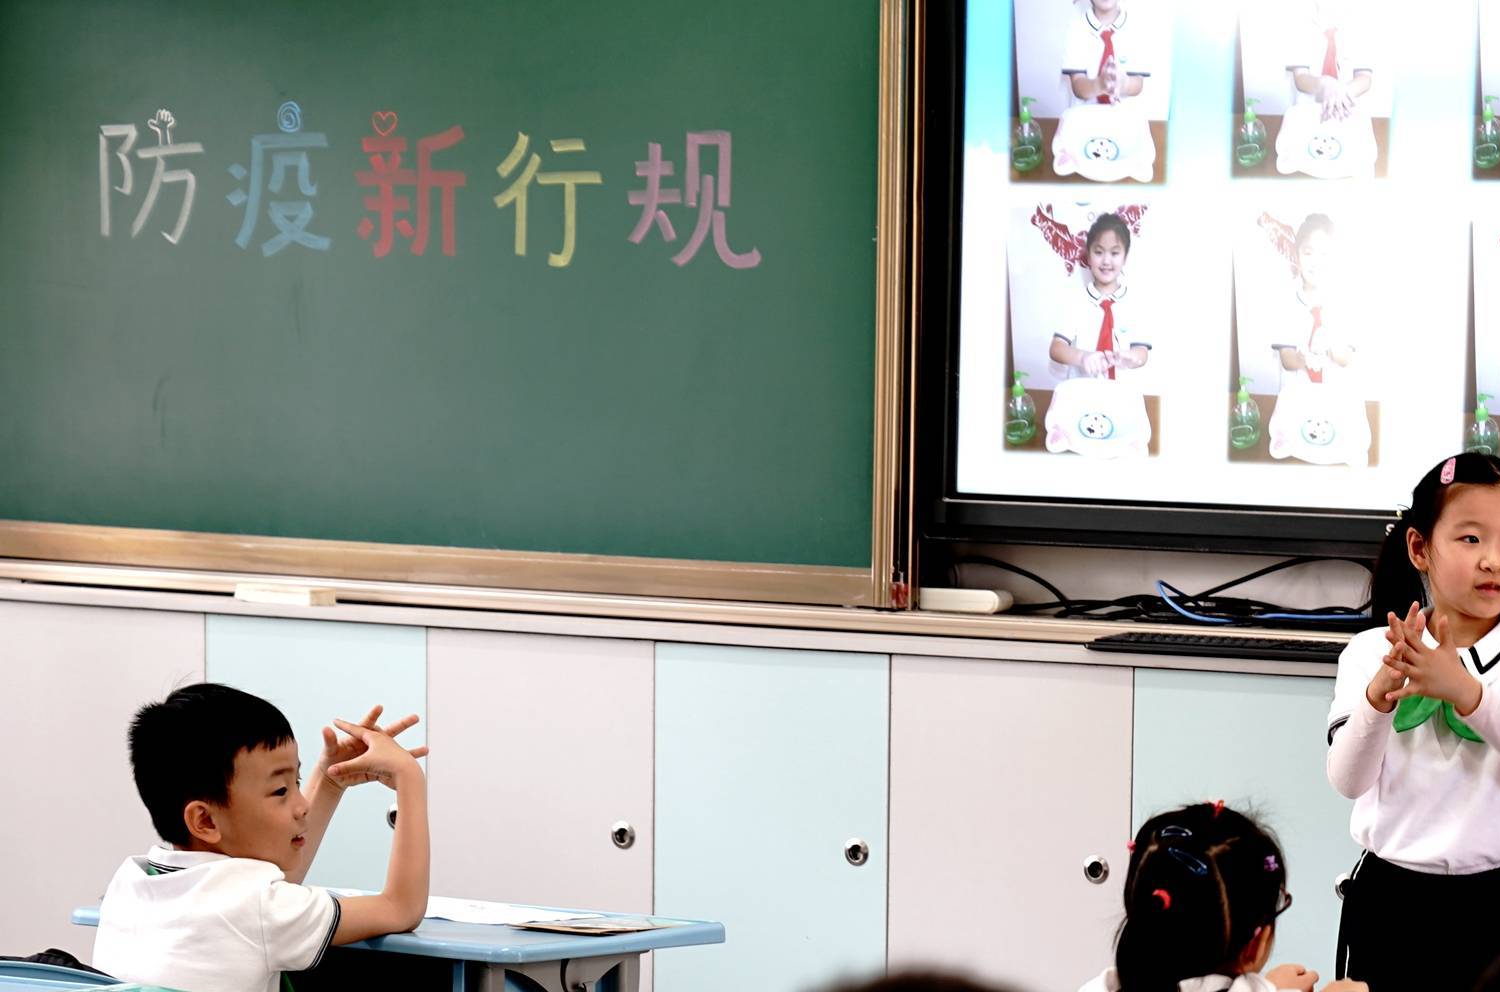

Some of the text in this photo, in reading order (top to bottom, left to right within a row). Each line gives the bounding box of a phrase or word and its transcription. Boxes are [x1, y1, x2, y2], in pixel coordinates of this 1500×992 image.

[99, 122, 762, 268] 防疫新行规
